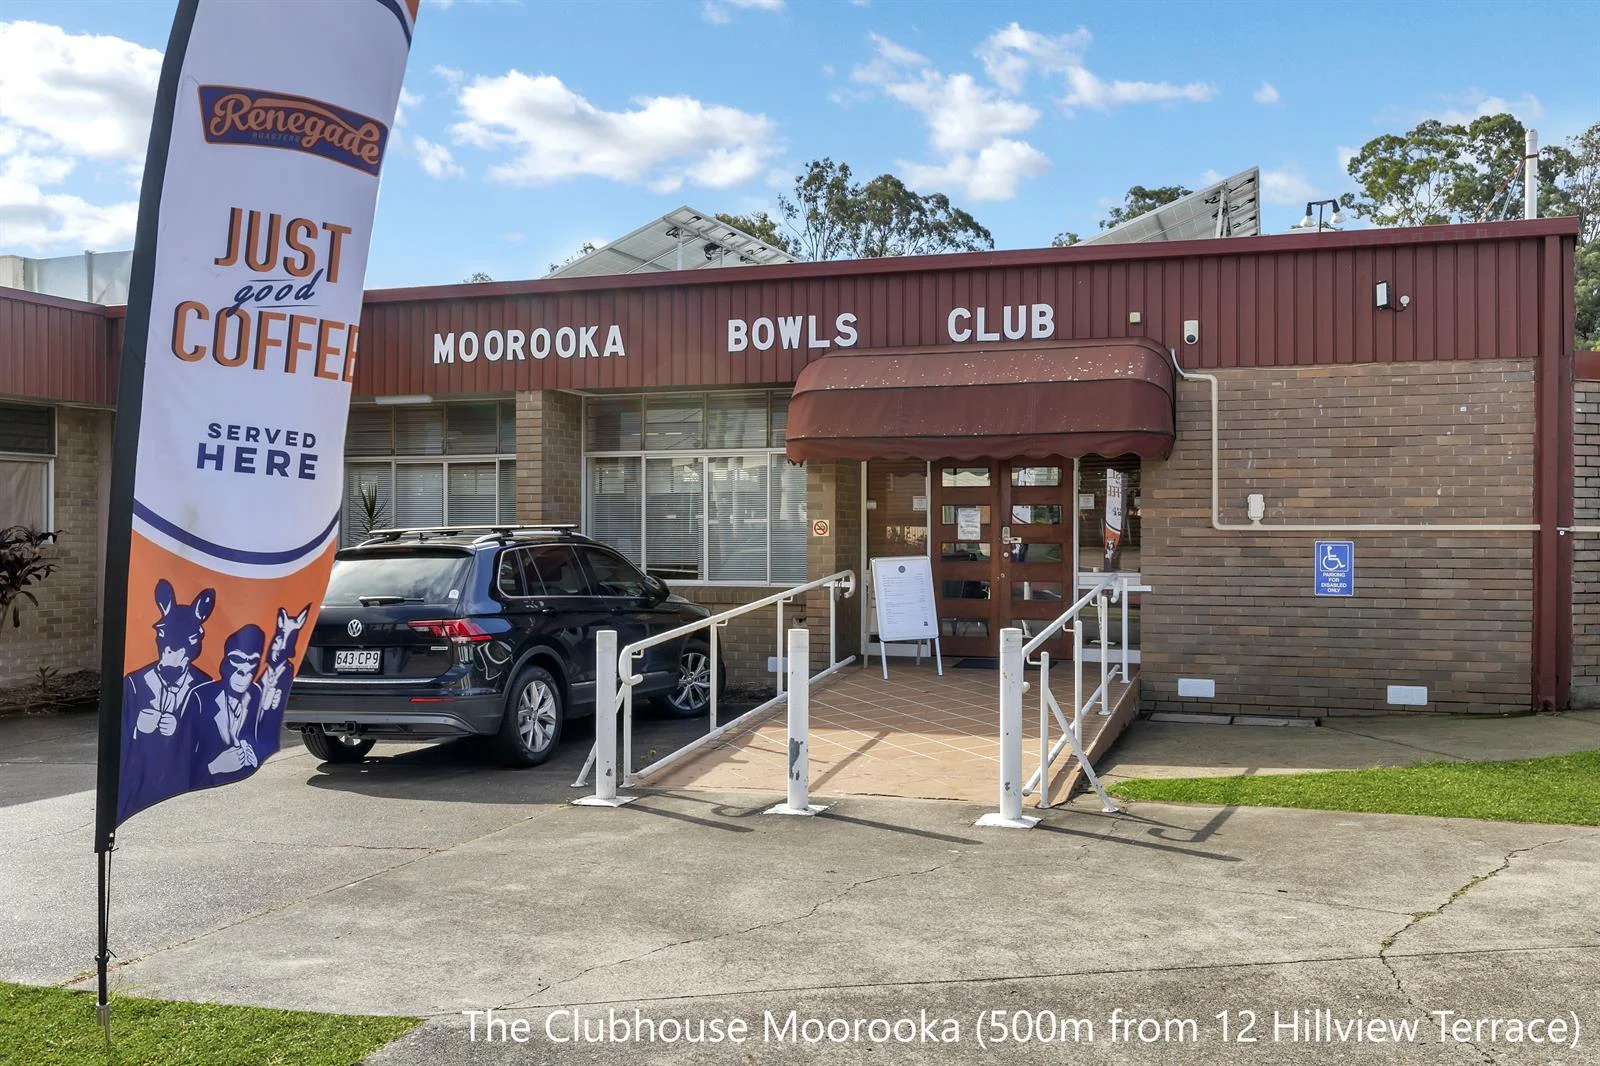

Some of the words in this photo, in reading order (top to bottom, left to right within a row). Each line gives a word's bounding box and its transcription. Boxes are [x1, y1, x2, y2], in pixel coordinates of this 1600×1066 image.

[210, 94, 378, 165] Renegade
[214, 207, 352, 284] JUST
[226, 268, 324, 317] good
[433, 325, 626, 363] MOOROOKA
[728, 313, 858, 352] BOWLS
[948, 303, 1055, 342] CLUB
[196, 442, 318, 480] HERE
[208, 423, 316, 448] SERVED
